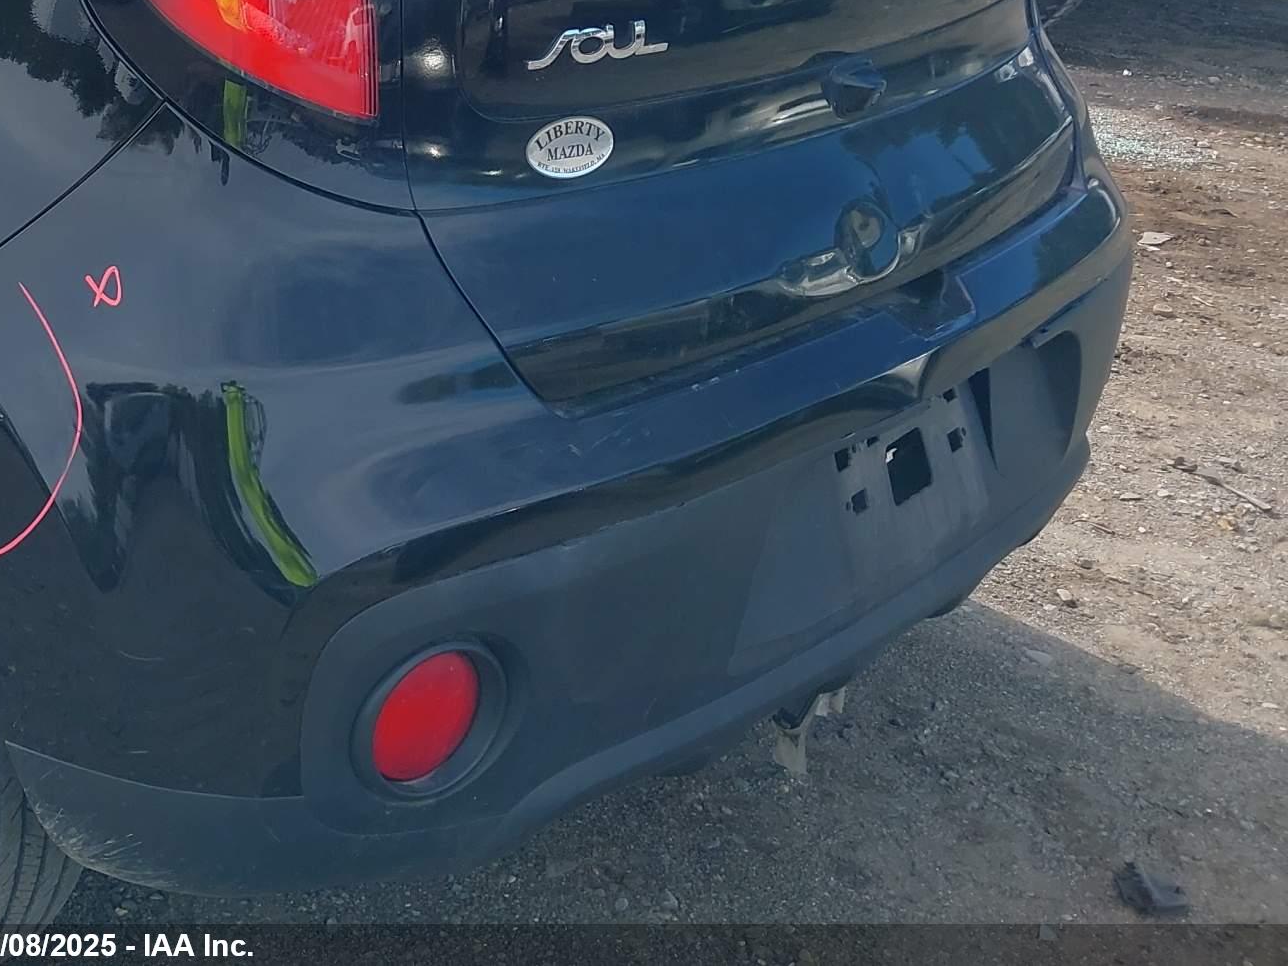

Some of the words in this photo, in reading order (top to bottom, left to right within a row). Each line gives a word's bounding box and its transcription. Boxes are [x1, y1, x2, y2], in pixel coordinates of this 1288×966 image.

[527, 19, 669, 71] SOUL
[534, 120, 606, 152] LIBERTY
[546, 142, 594, 162] MAZDA
